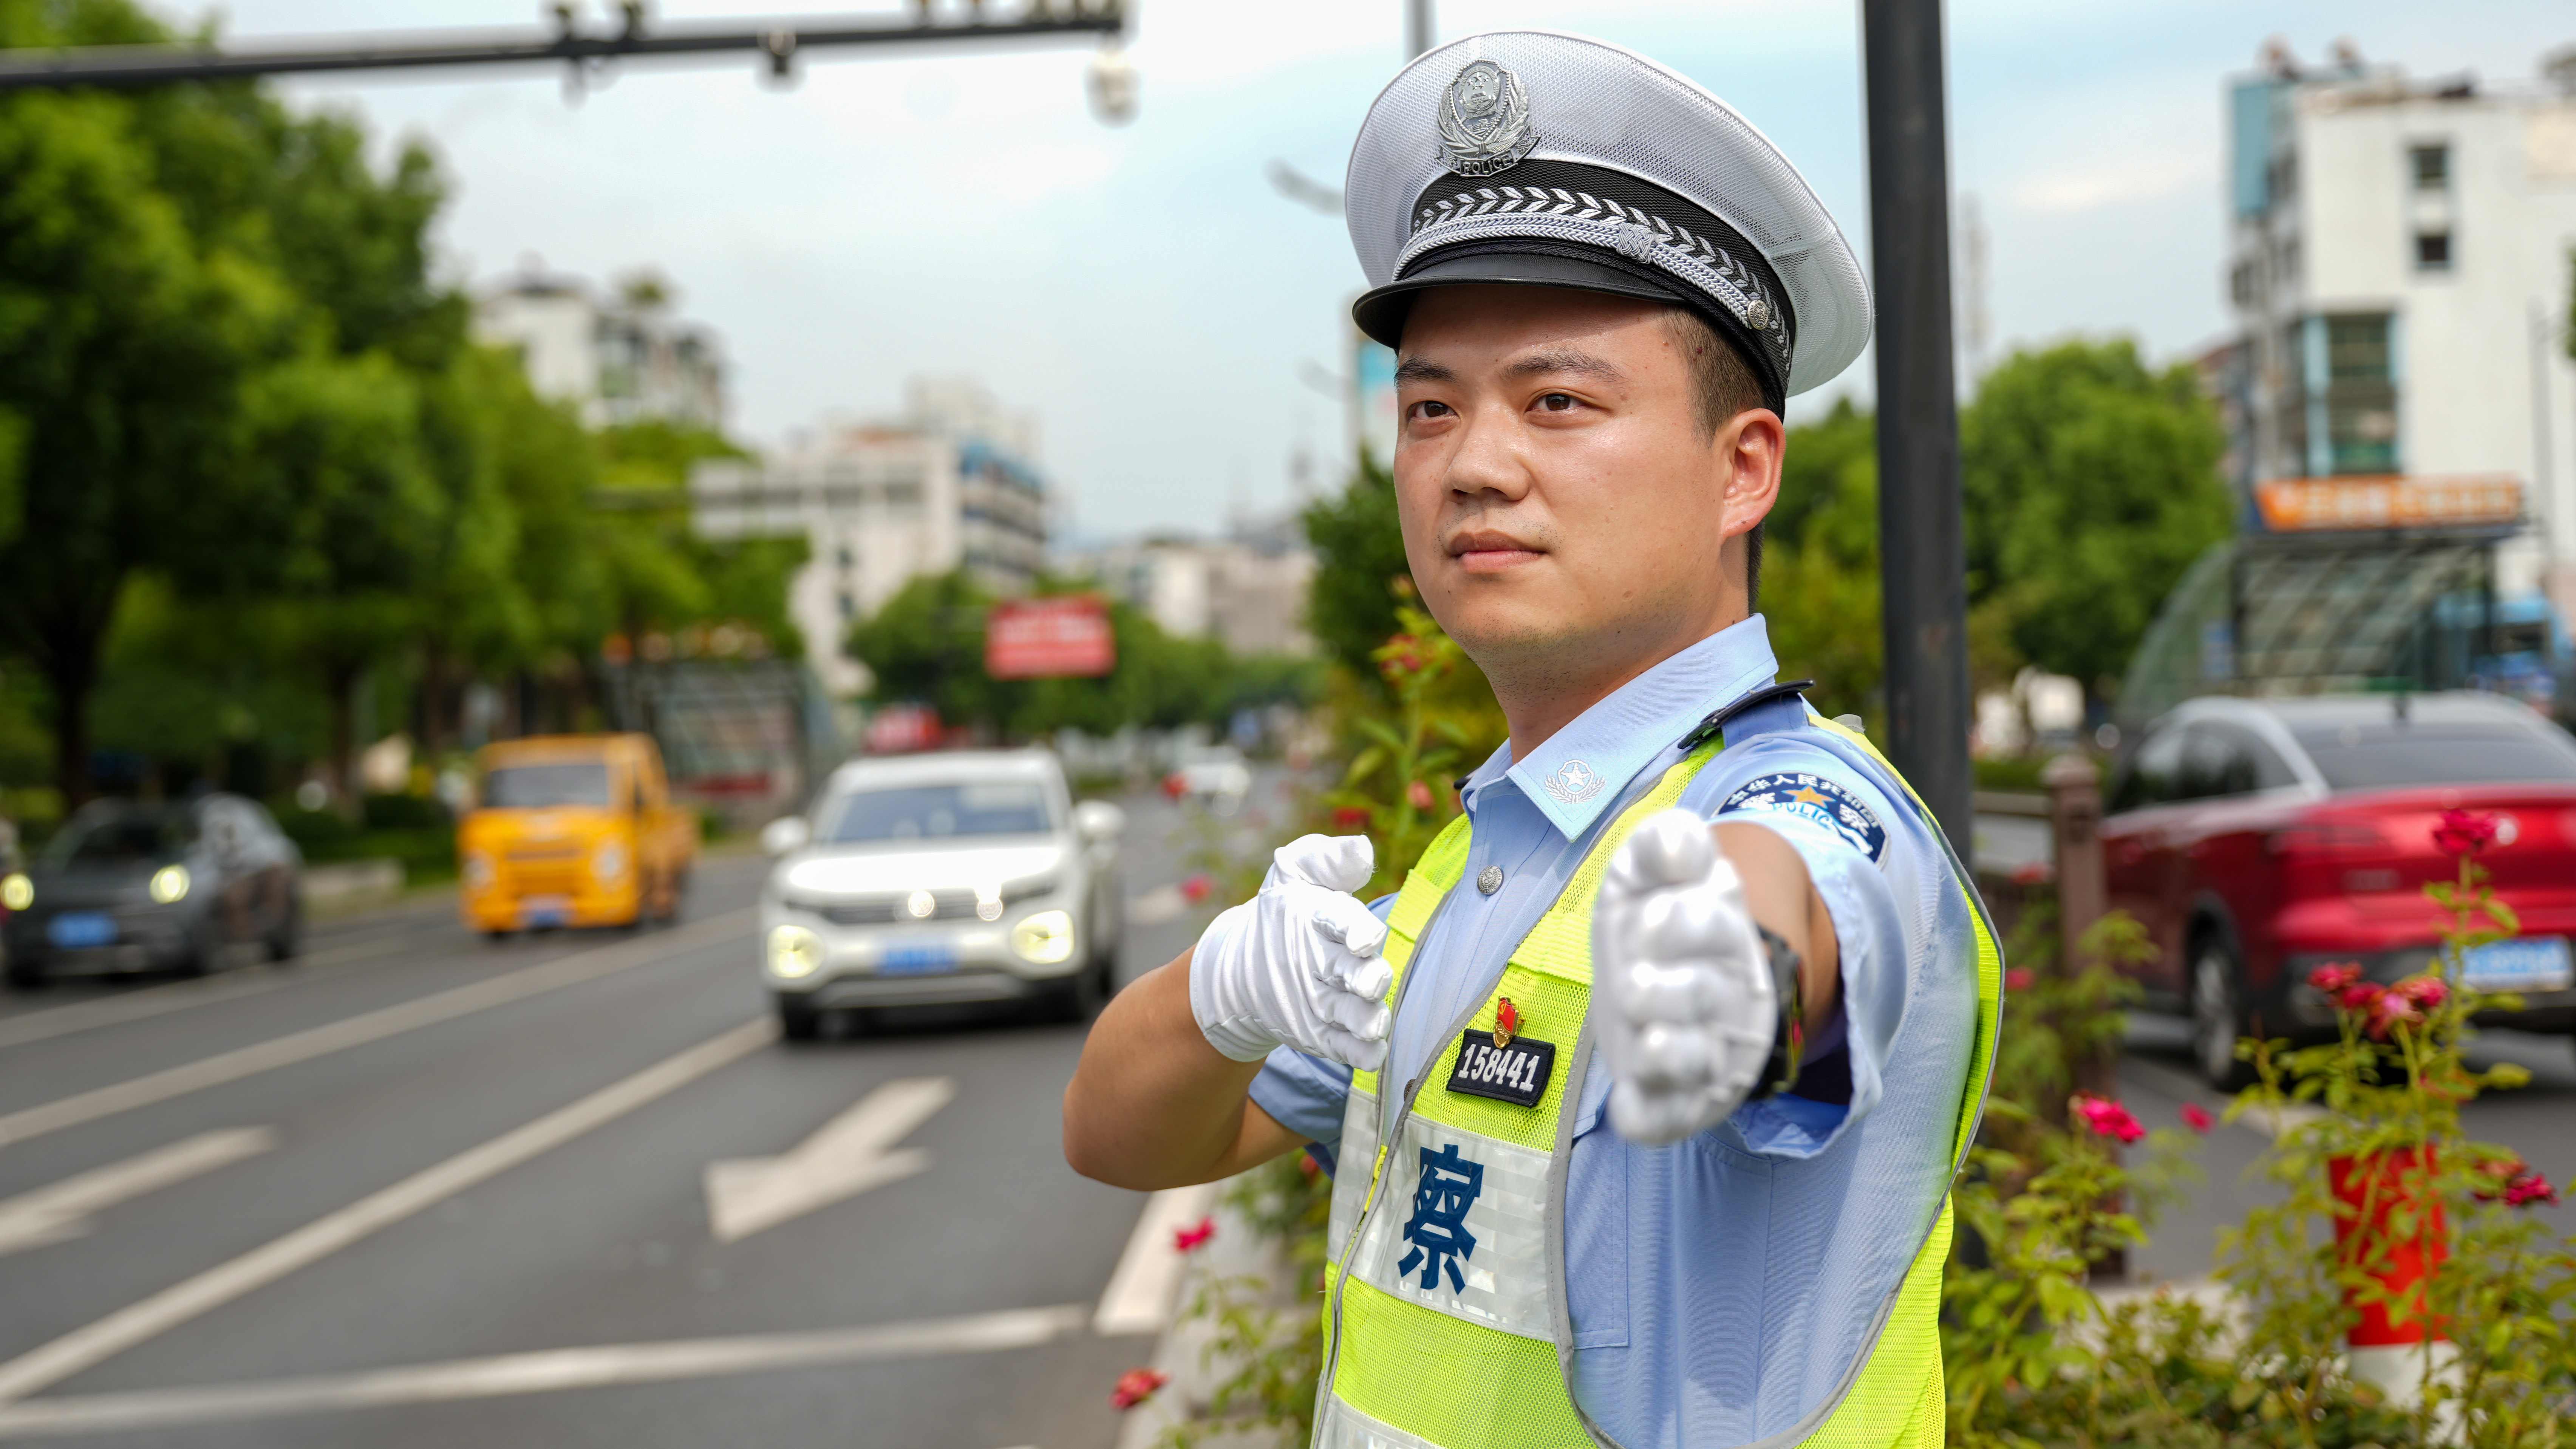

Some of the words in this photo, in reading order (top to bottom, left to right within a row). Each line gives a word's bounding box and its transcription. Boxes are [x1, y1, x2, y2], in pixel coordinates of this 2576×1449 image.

[1463, 154, 1512, 174] POLICE
[1728, 774, 1879, 828] 中华人民共和国
[1772, 801, 1831, 823] POLIC
[1458, 1044, 1540, 1092] 158441
[1398, 1144, 1484, 1295] 察
